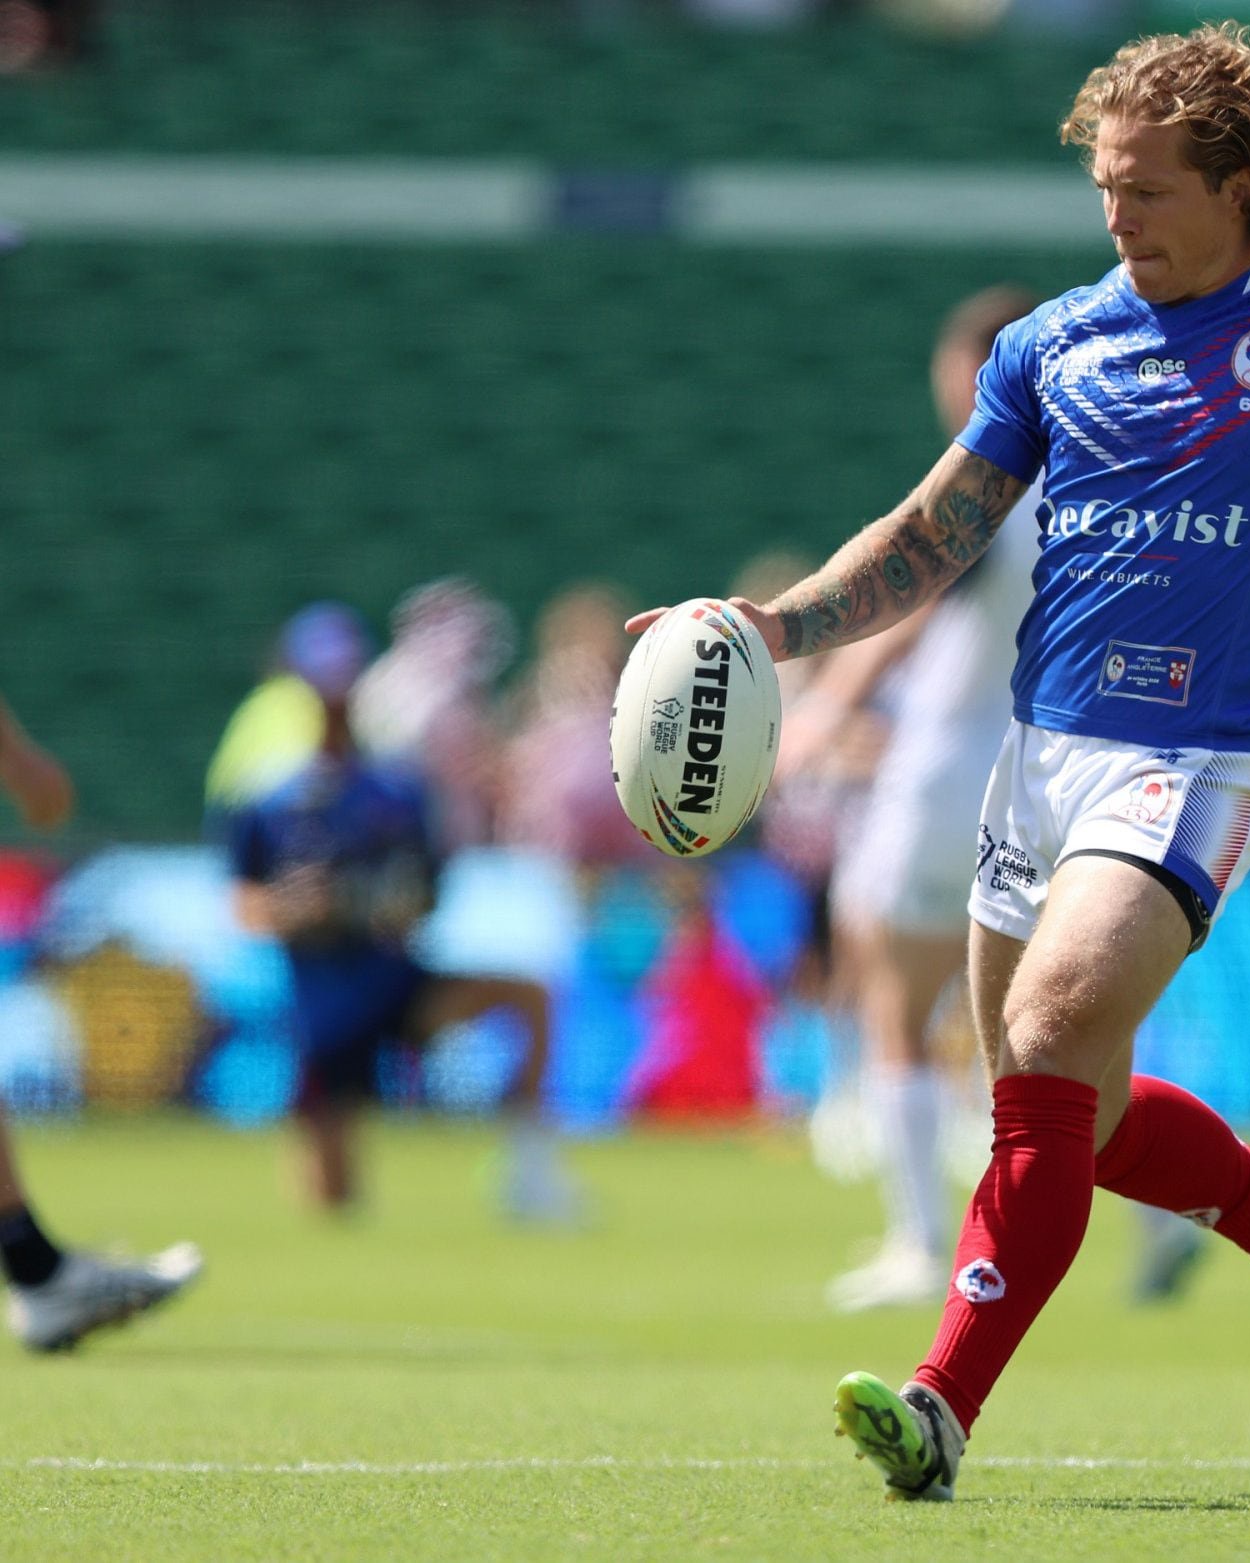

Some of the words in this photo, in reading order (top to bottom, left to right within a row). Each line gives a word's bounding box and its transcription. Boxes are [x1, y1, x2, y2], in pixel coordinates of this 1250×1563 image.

[1100, 570, 1171, 587] CABINETS
[655, 721, 664, 751] WORLD
[661, 721, 671, 755] LEAGUE
[669, 722, 678, 751] RUGBY
[678, 639, 731, 815] STEEDEN
[994, 864, 1033, 889] WORLD
[995, 853, 1038, 880] LEAGUE
[990, 877, 1010, 892] CUP
